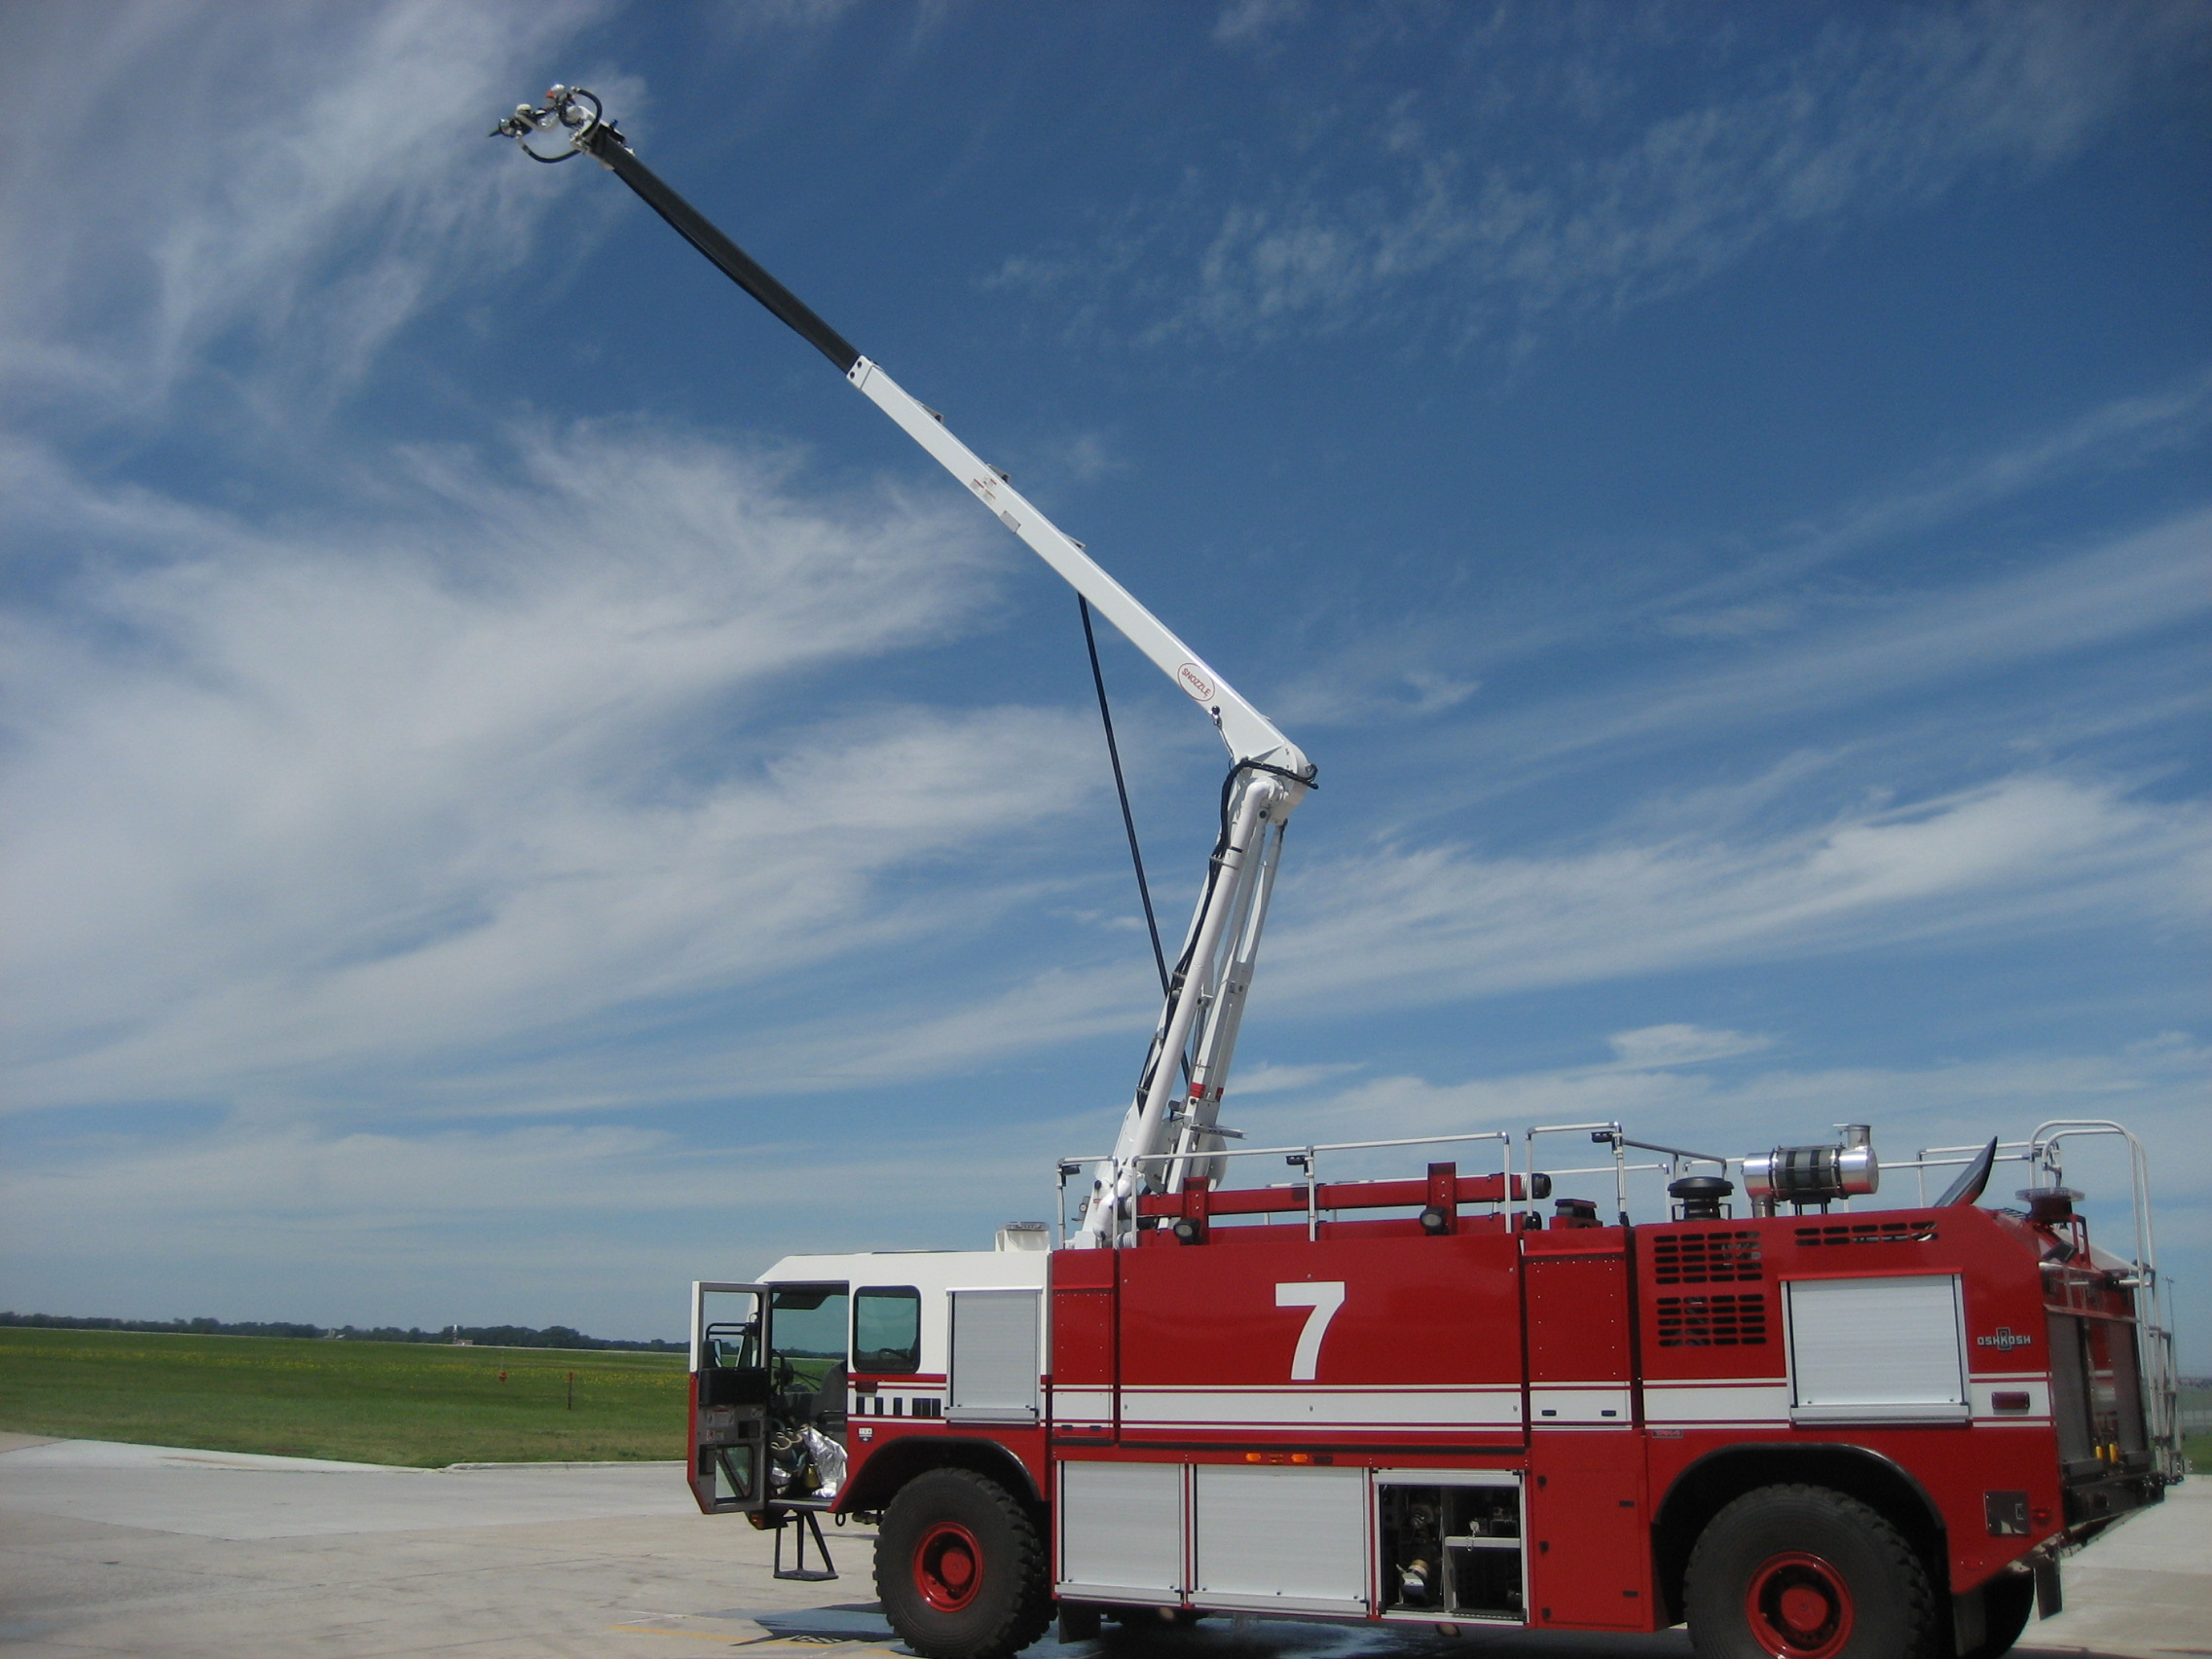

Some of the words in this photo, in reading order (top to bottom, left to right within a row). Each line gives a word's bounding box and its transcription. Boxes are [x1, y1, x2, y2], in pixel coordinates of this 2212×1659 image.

[1181, 668, 1211, 696] SNOZZLE
[1275, 1281, 1345, 1380] 7
[1977, 1335, 2031, 1345] OSHKOSH
